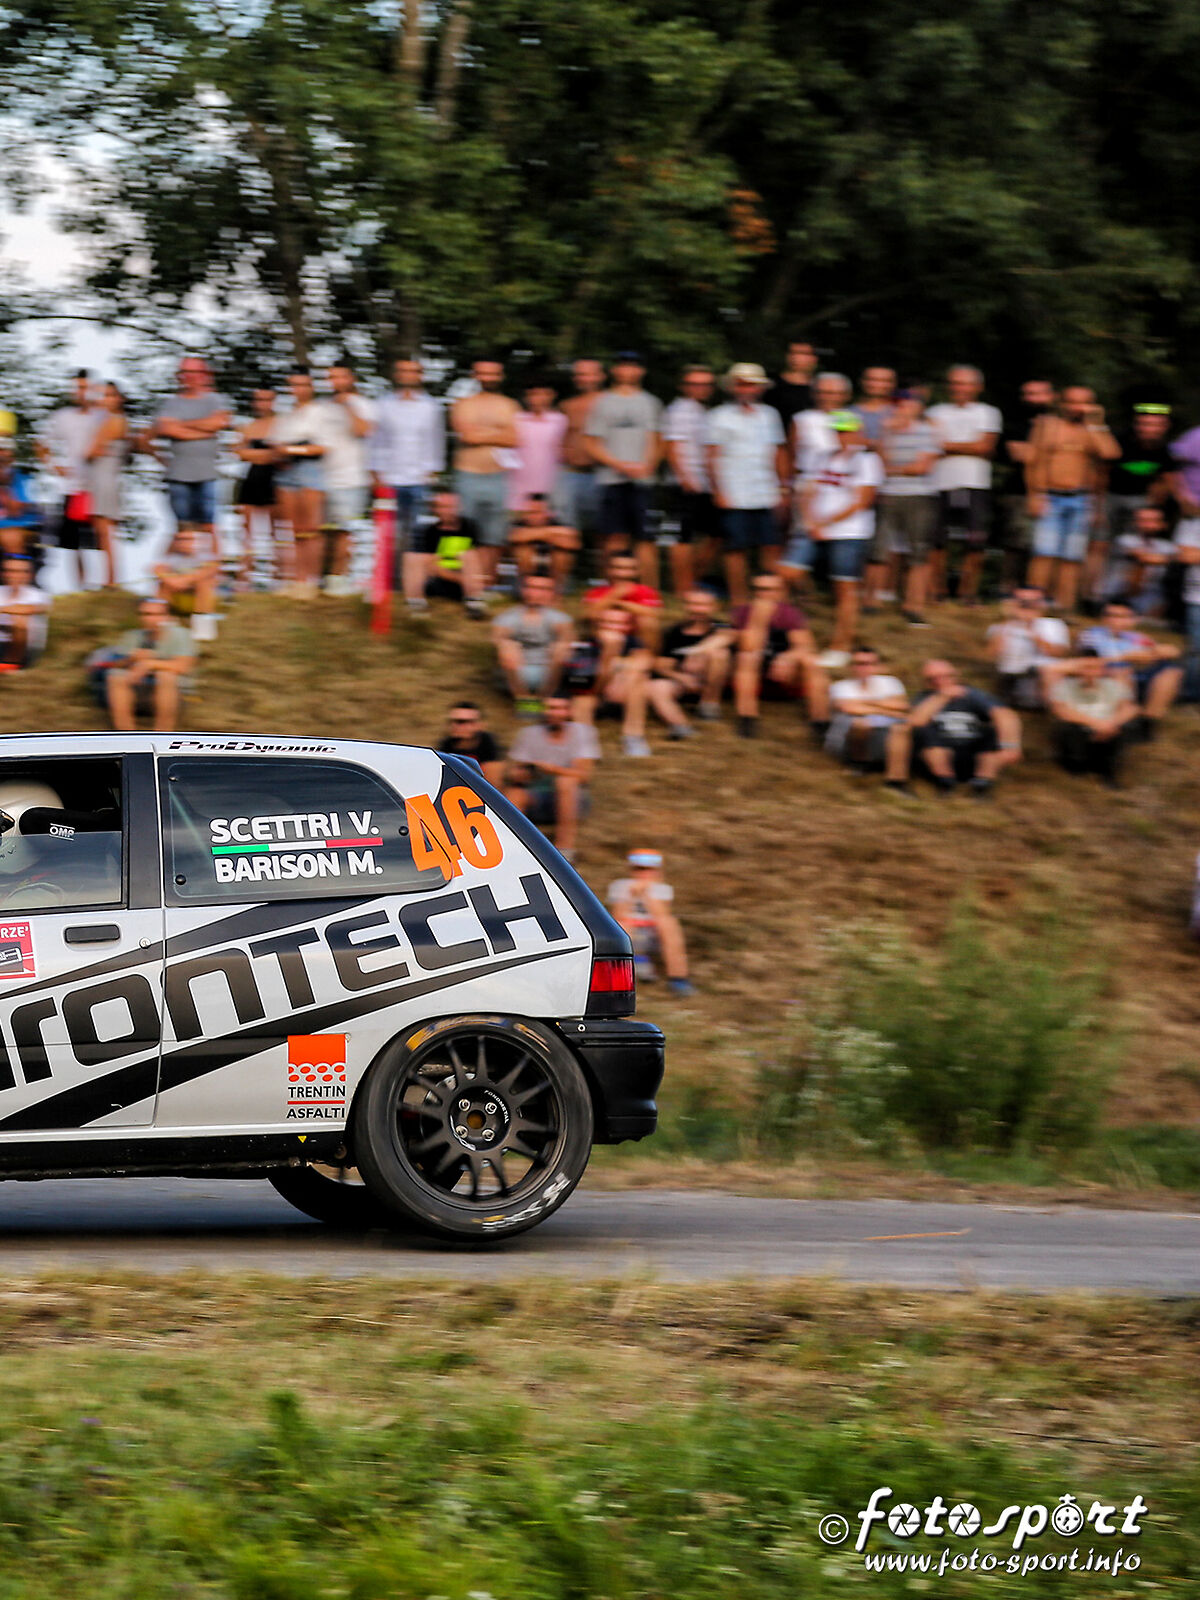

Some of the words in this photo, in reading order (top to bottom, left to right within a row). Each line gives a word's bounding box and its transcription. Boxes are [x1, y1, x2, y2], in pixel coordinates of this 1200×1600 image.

[169, 741, 337, 754] ProDynamic
[49, 825, 75, 838] OMP
[208, 811, 342, 843] SCETTRI
[347, 810, 381, 836] V.
[404, 786, 504, 881] 46
[214, 852, 342, 883] BARISON
[348, 850, 384, 876] M.
[287, 1086, 346, 1098] TRENTIN
[286, 1108, 345, 1118] ASFALTI
